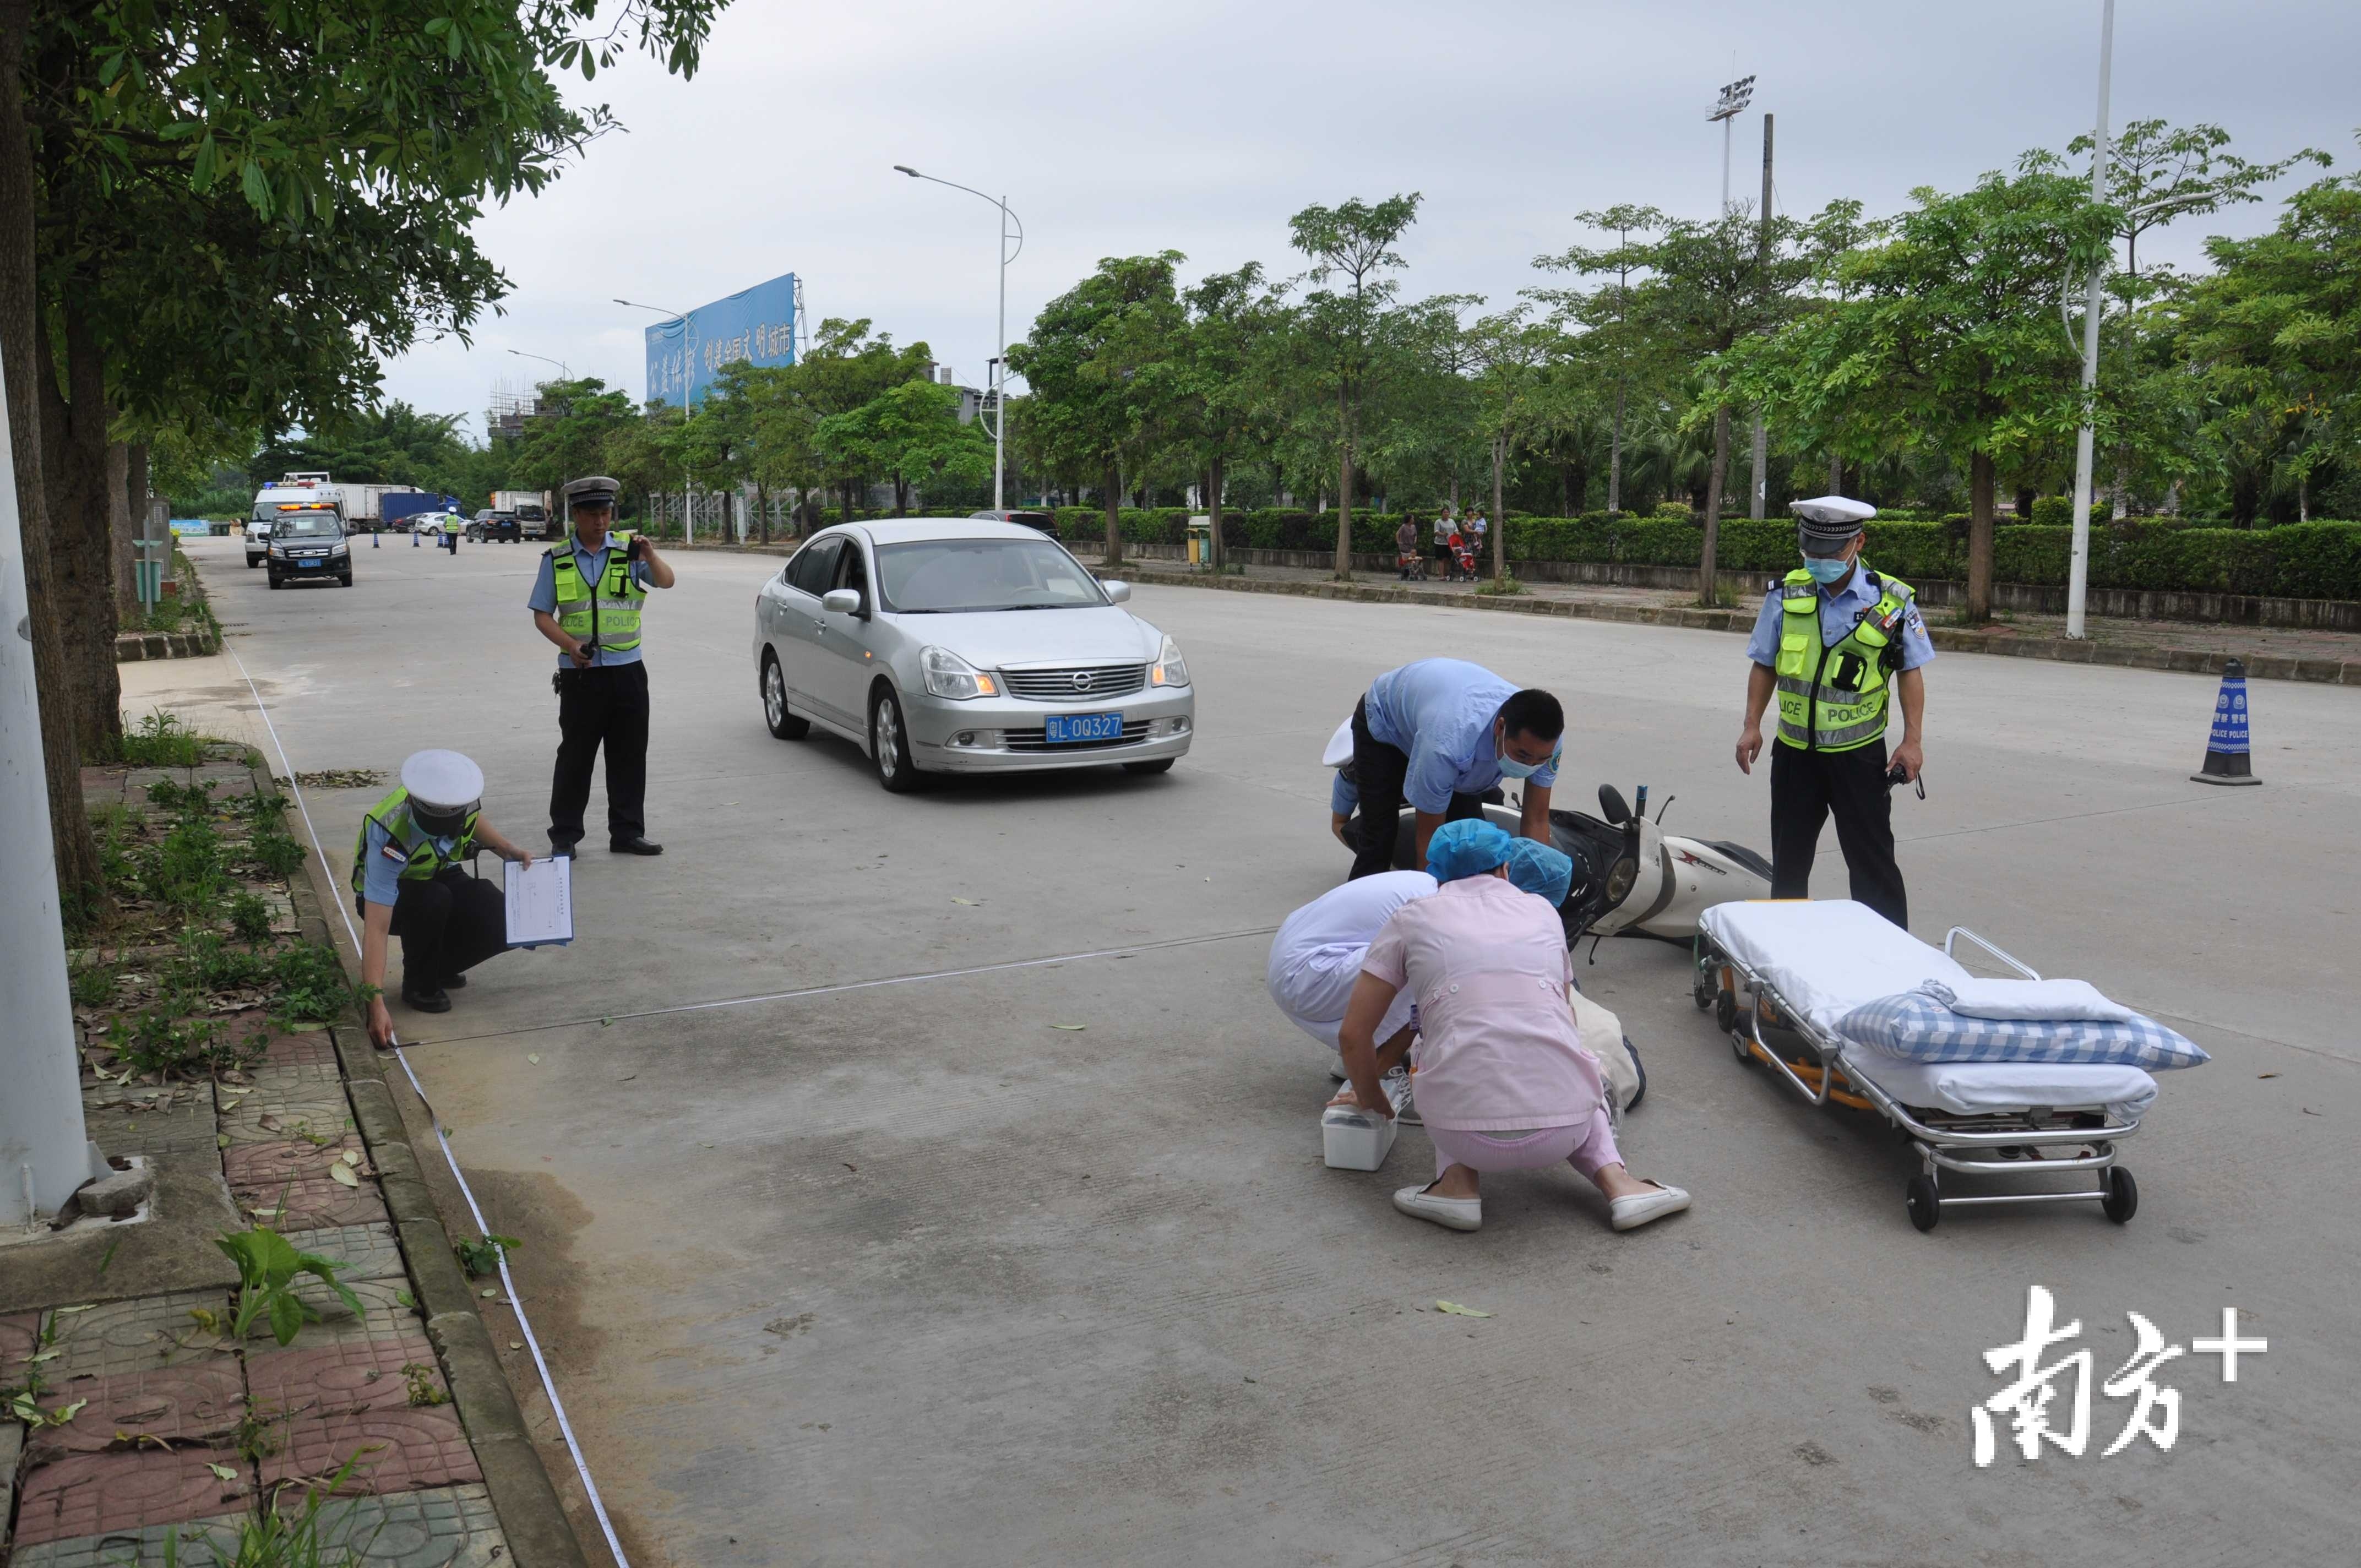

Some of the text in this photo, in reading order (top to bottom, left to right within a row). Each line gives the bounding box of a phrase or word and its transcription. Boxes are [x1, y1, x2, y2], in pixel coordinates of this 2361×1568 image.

[704, 322, 790, 373] 创建全国文明城市
[1827, 702, 1876, 722] POLICE
[2229, 730, 2248, 738] POLICE
